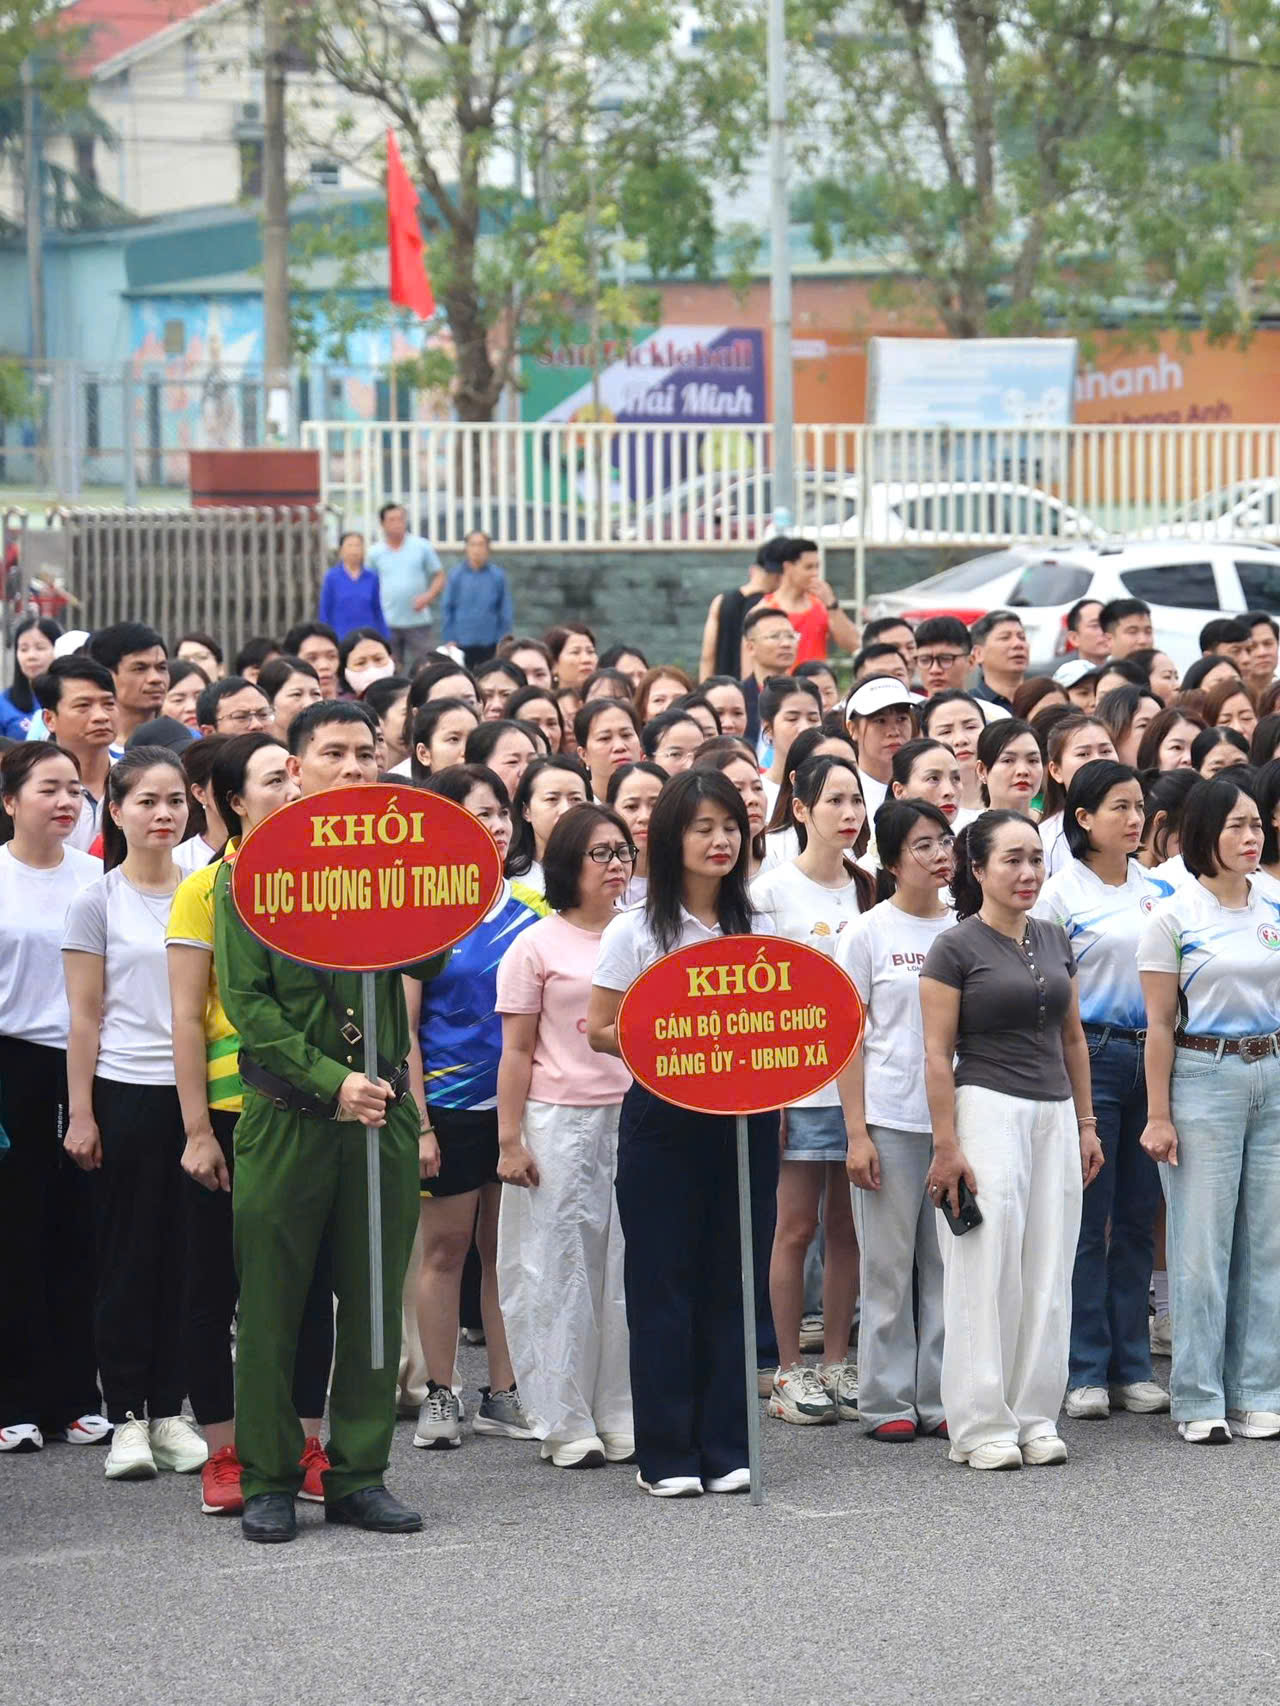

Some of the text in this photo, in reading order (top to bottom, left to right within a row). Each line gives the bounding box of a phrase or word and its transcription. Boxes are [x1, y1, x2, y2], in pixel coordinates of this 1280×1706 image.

[681, 381, 753, 417] Minh
[310, 796, 425, 847] KHỐI
[254, 858, 480, 923] LỰC LƯỢNG VŨ TRANG
[685, 946, 792, 997] KHỐI
[655, 1004, 827, 1041] CÁN BỘ CÔNG CHỨC
[655, 1047, 706, 1078] ĐẢNG
[710, 1044, 734, 1073] ỦY
[751, 1045, 799, 1070] UBND
[804, 1040, 829, 1067] XÃ
